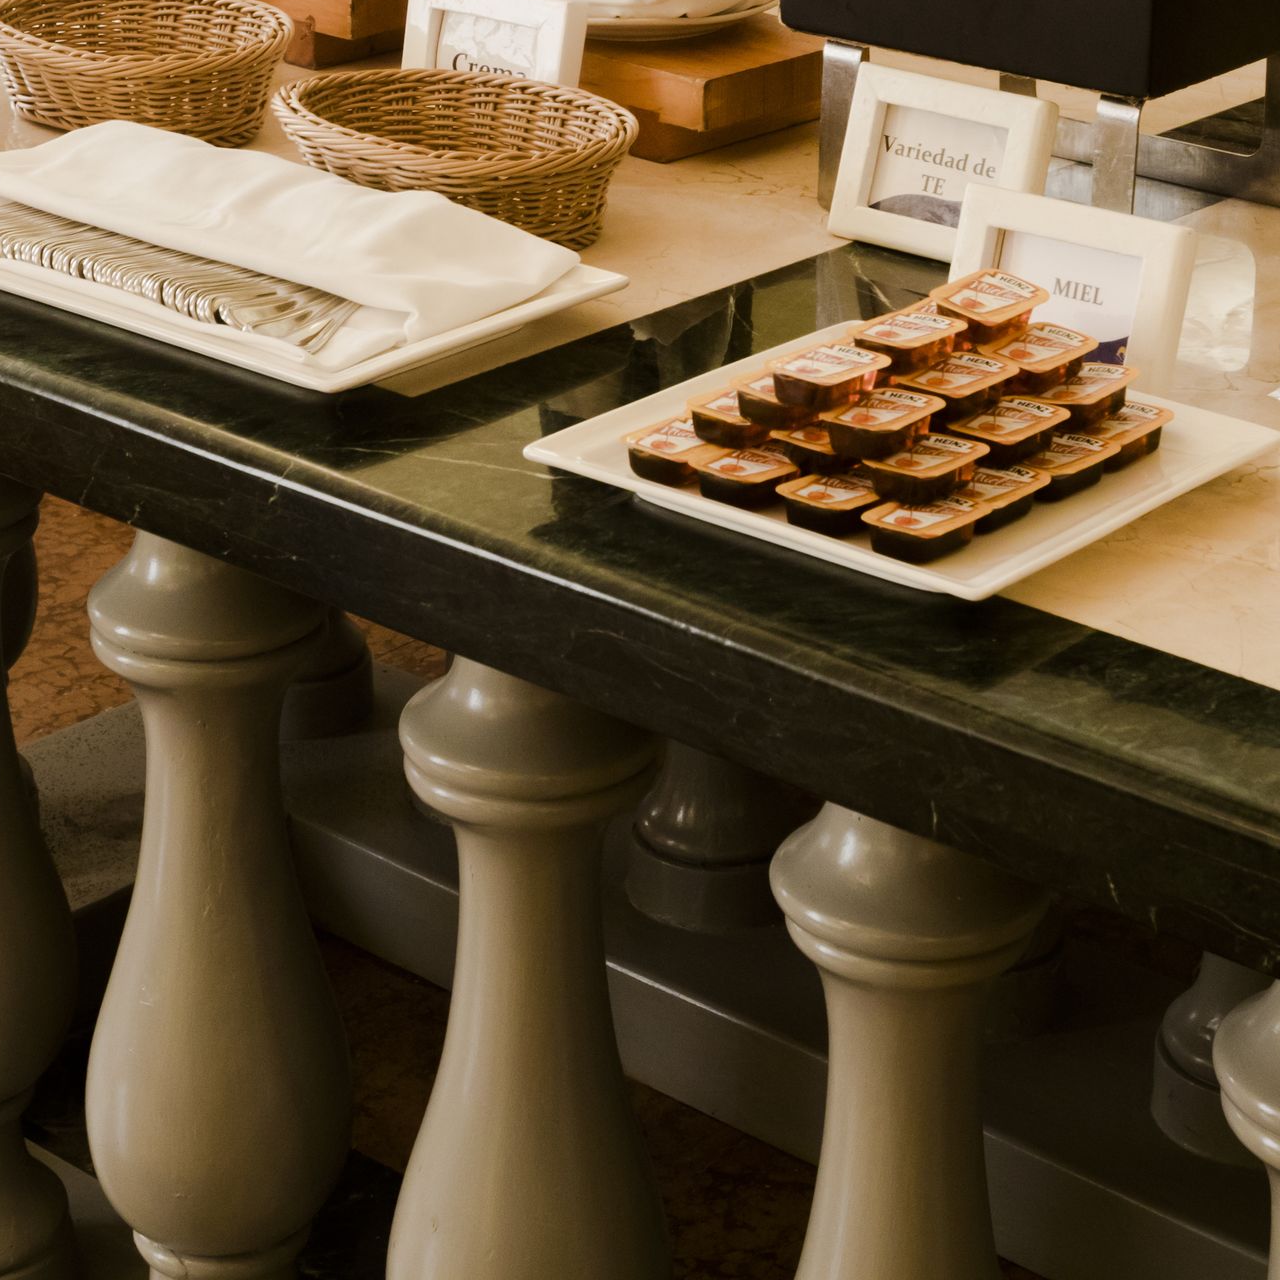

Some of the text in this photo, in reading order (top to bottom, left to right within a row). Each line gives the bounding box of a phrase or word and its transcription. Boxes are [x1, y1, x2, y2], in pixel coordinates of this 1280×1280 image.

[883, 134, 997, 179] Variedad de
[921, 174, 947, 197] TE
[999, 275, 1031, 291] HEINZ
[1052, 277, 1104, 306] MIEL
[913, 314, 946, 326] HEINZ
[1048, 328, 1079, 340] HEINZ
[838, 347, 870, 358] HEINZ
[966, 357, 998, 367] HEINZ
[1087, 366, 1119, 375] HEINZ
[889, 392, 922, 402] HEINZ
[1017, 401, 1049, 413] HEINZ
[934, 438, 967, 448] HEINZ
[1067, 435, 1099, 446] HEINZ
[1011, 466, 1030, 477] INZ
